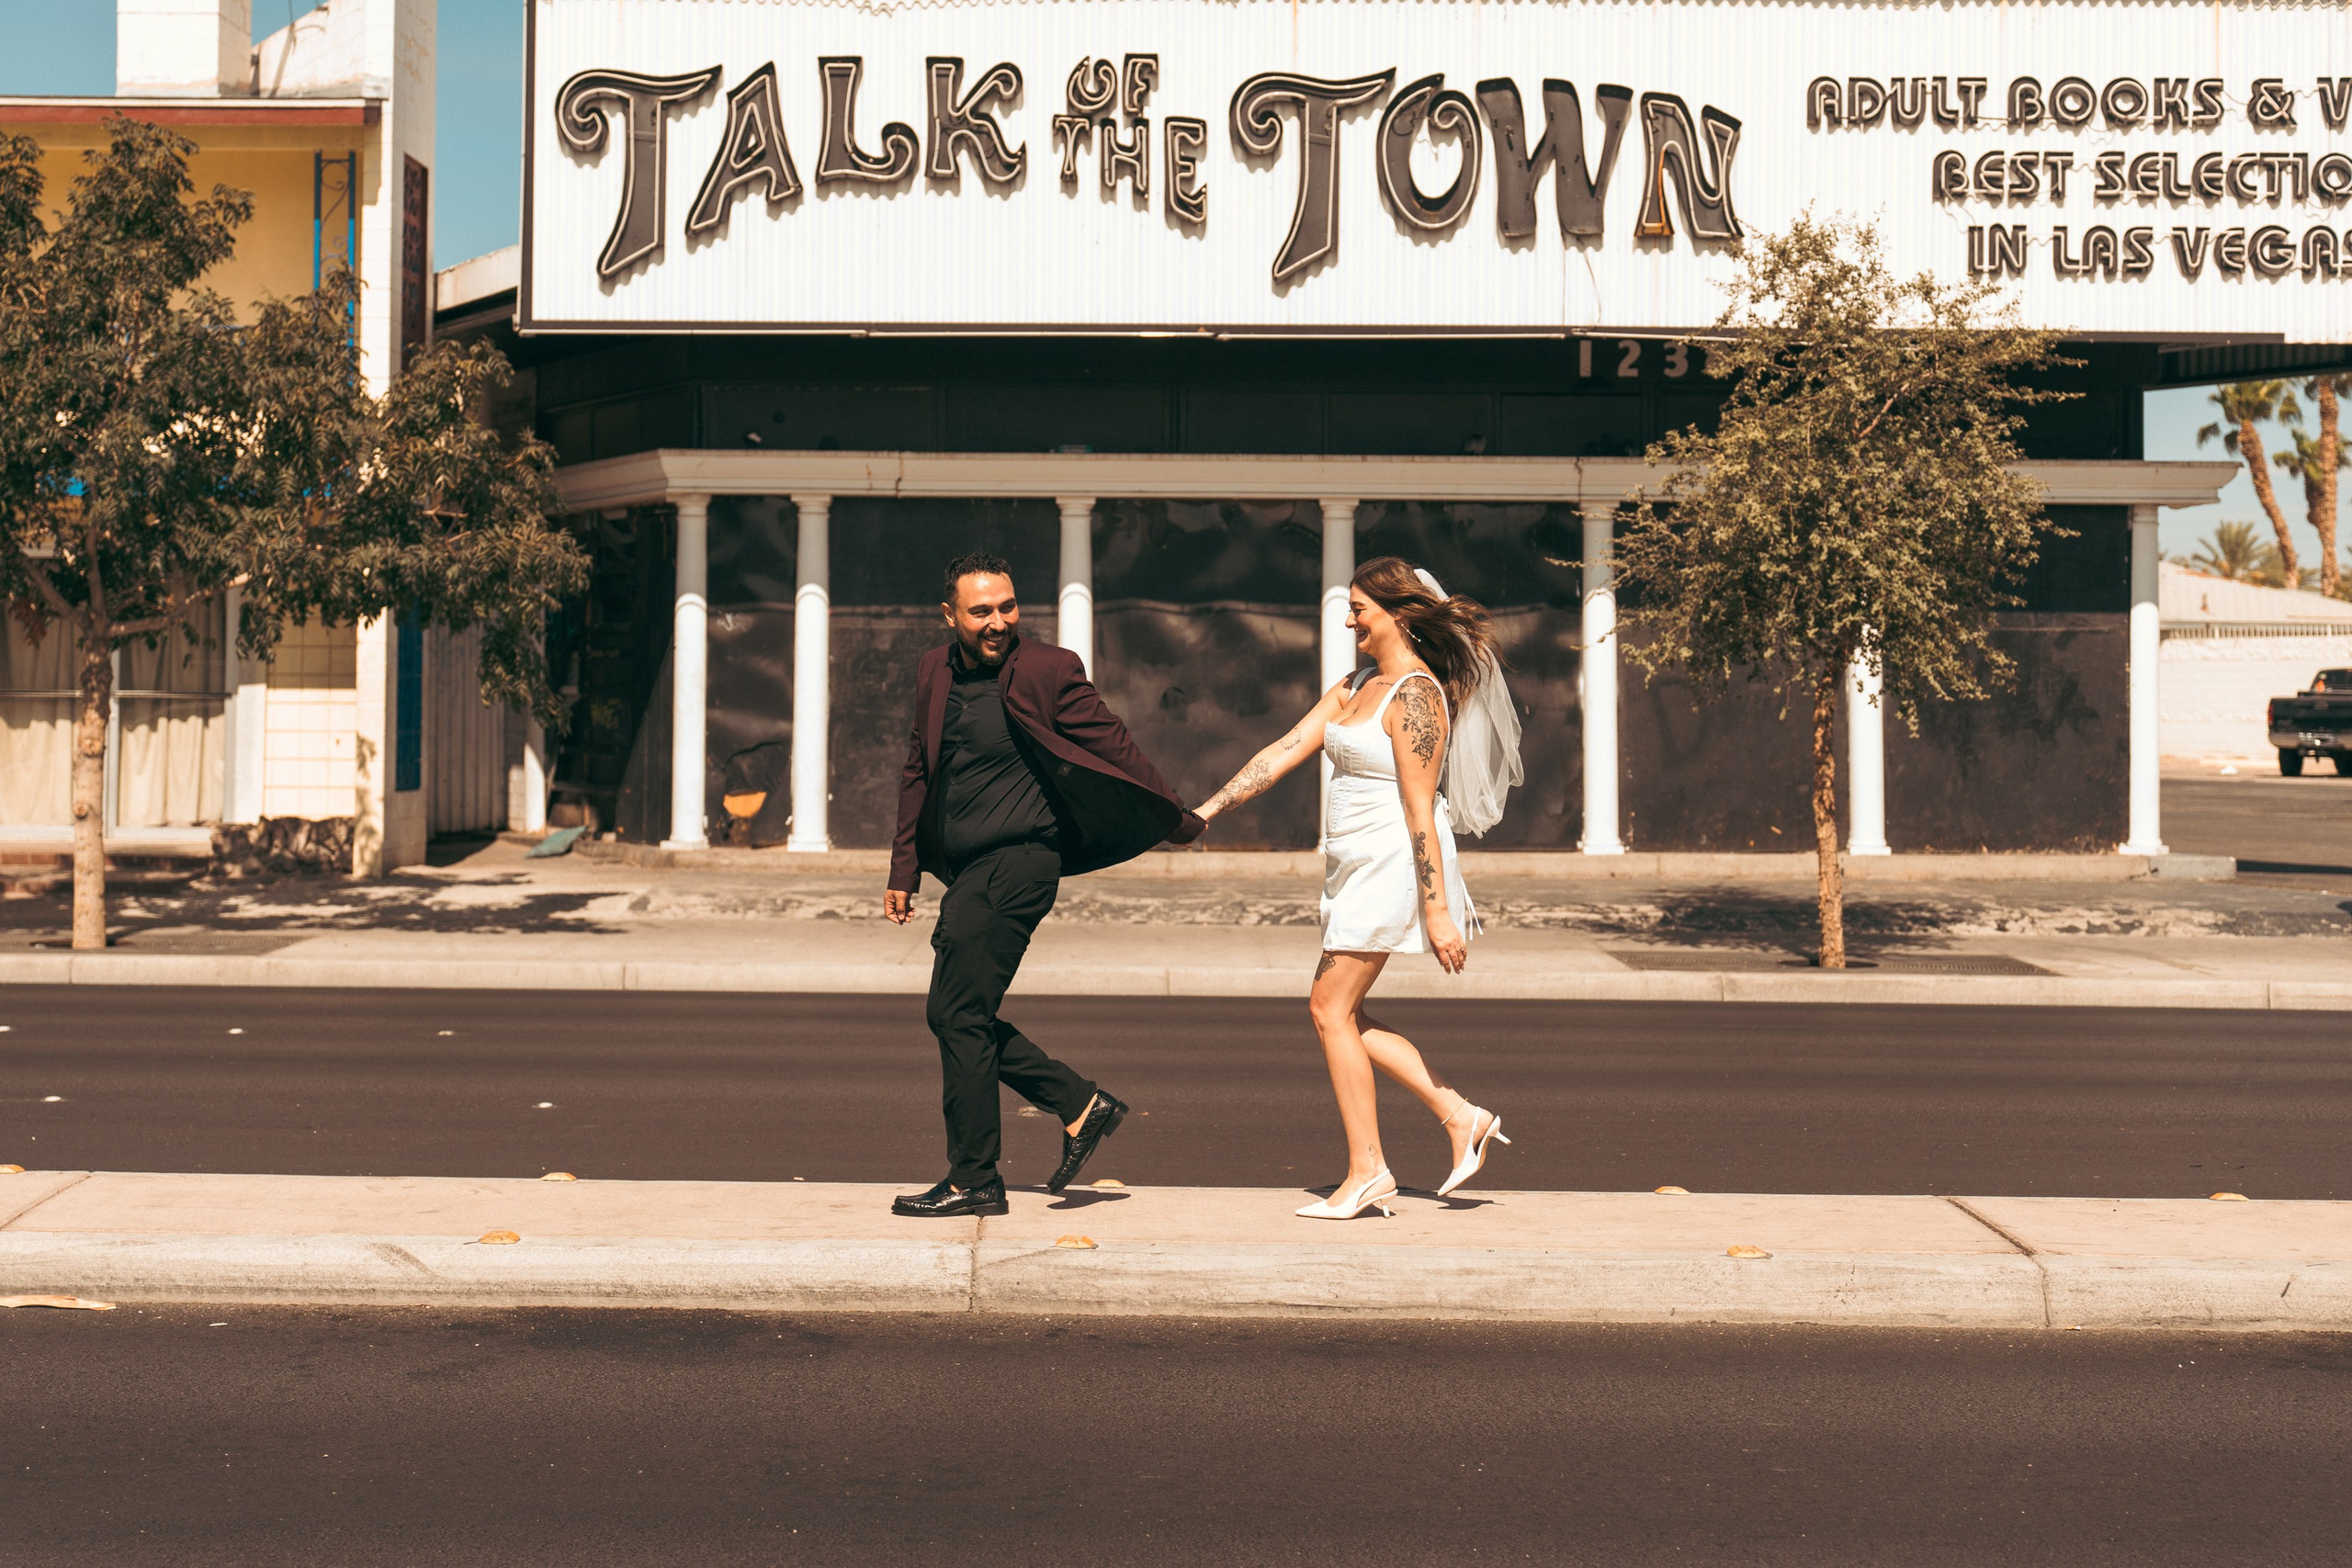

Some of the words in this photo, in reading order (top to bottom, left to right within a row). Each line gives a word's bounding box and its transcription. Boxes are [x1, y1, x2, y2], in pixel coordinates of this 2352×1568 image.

[1066, 52, 1159, 114] OF
[1807, 76, 1987, 127] ADULT
[2007, 76, 2224, 127] BOOKS
[2246, 78, 2298, 127] &
[554, 56, 1026, 277] TALK
[1052, 114, 1207, 223] THE
[1229, 67, 1745, 280] TOWN
[1932, 150, 2073, 199] BEST
[1968, 225, 2027, 275] IN
[2052, 225, 2154, 275] LAS
